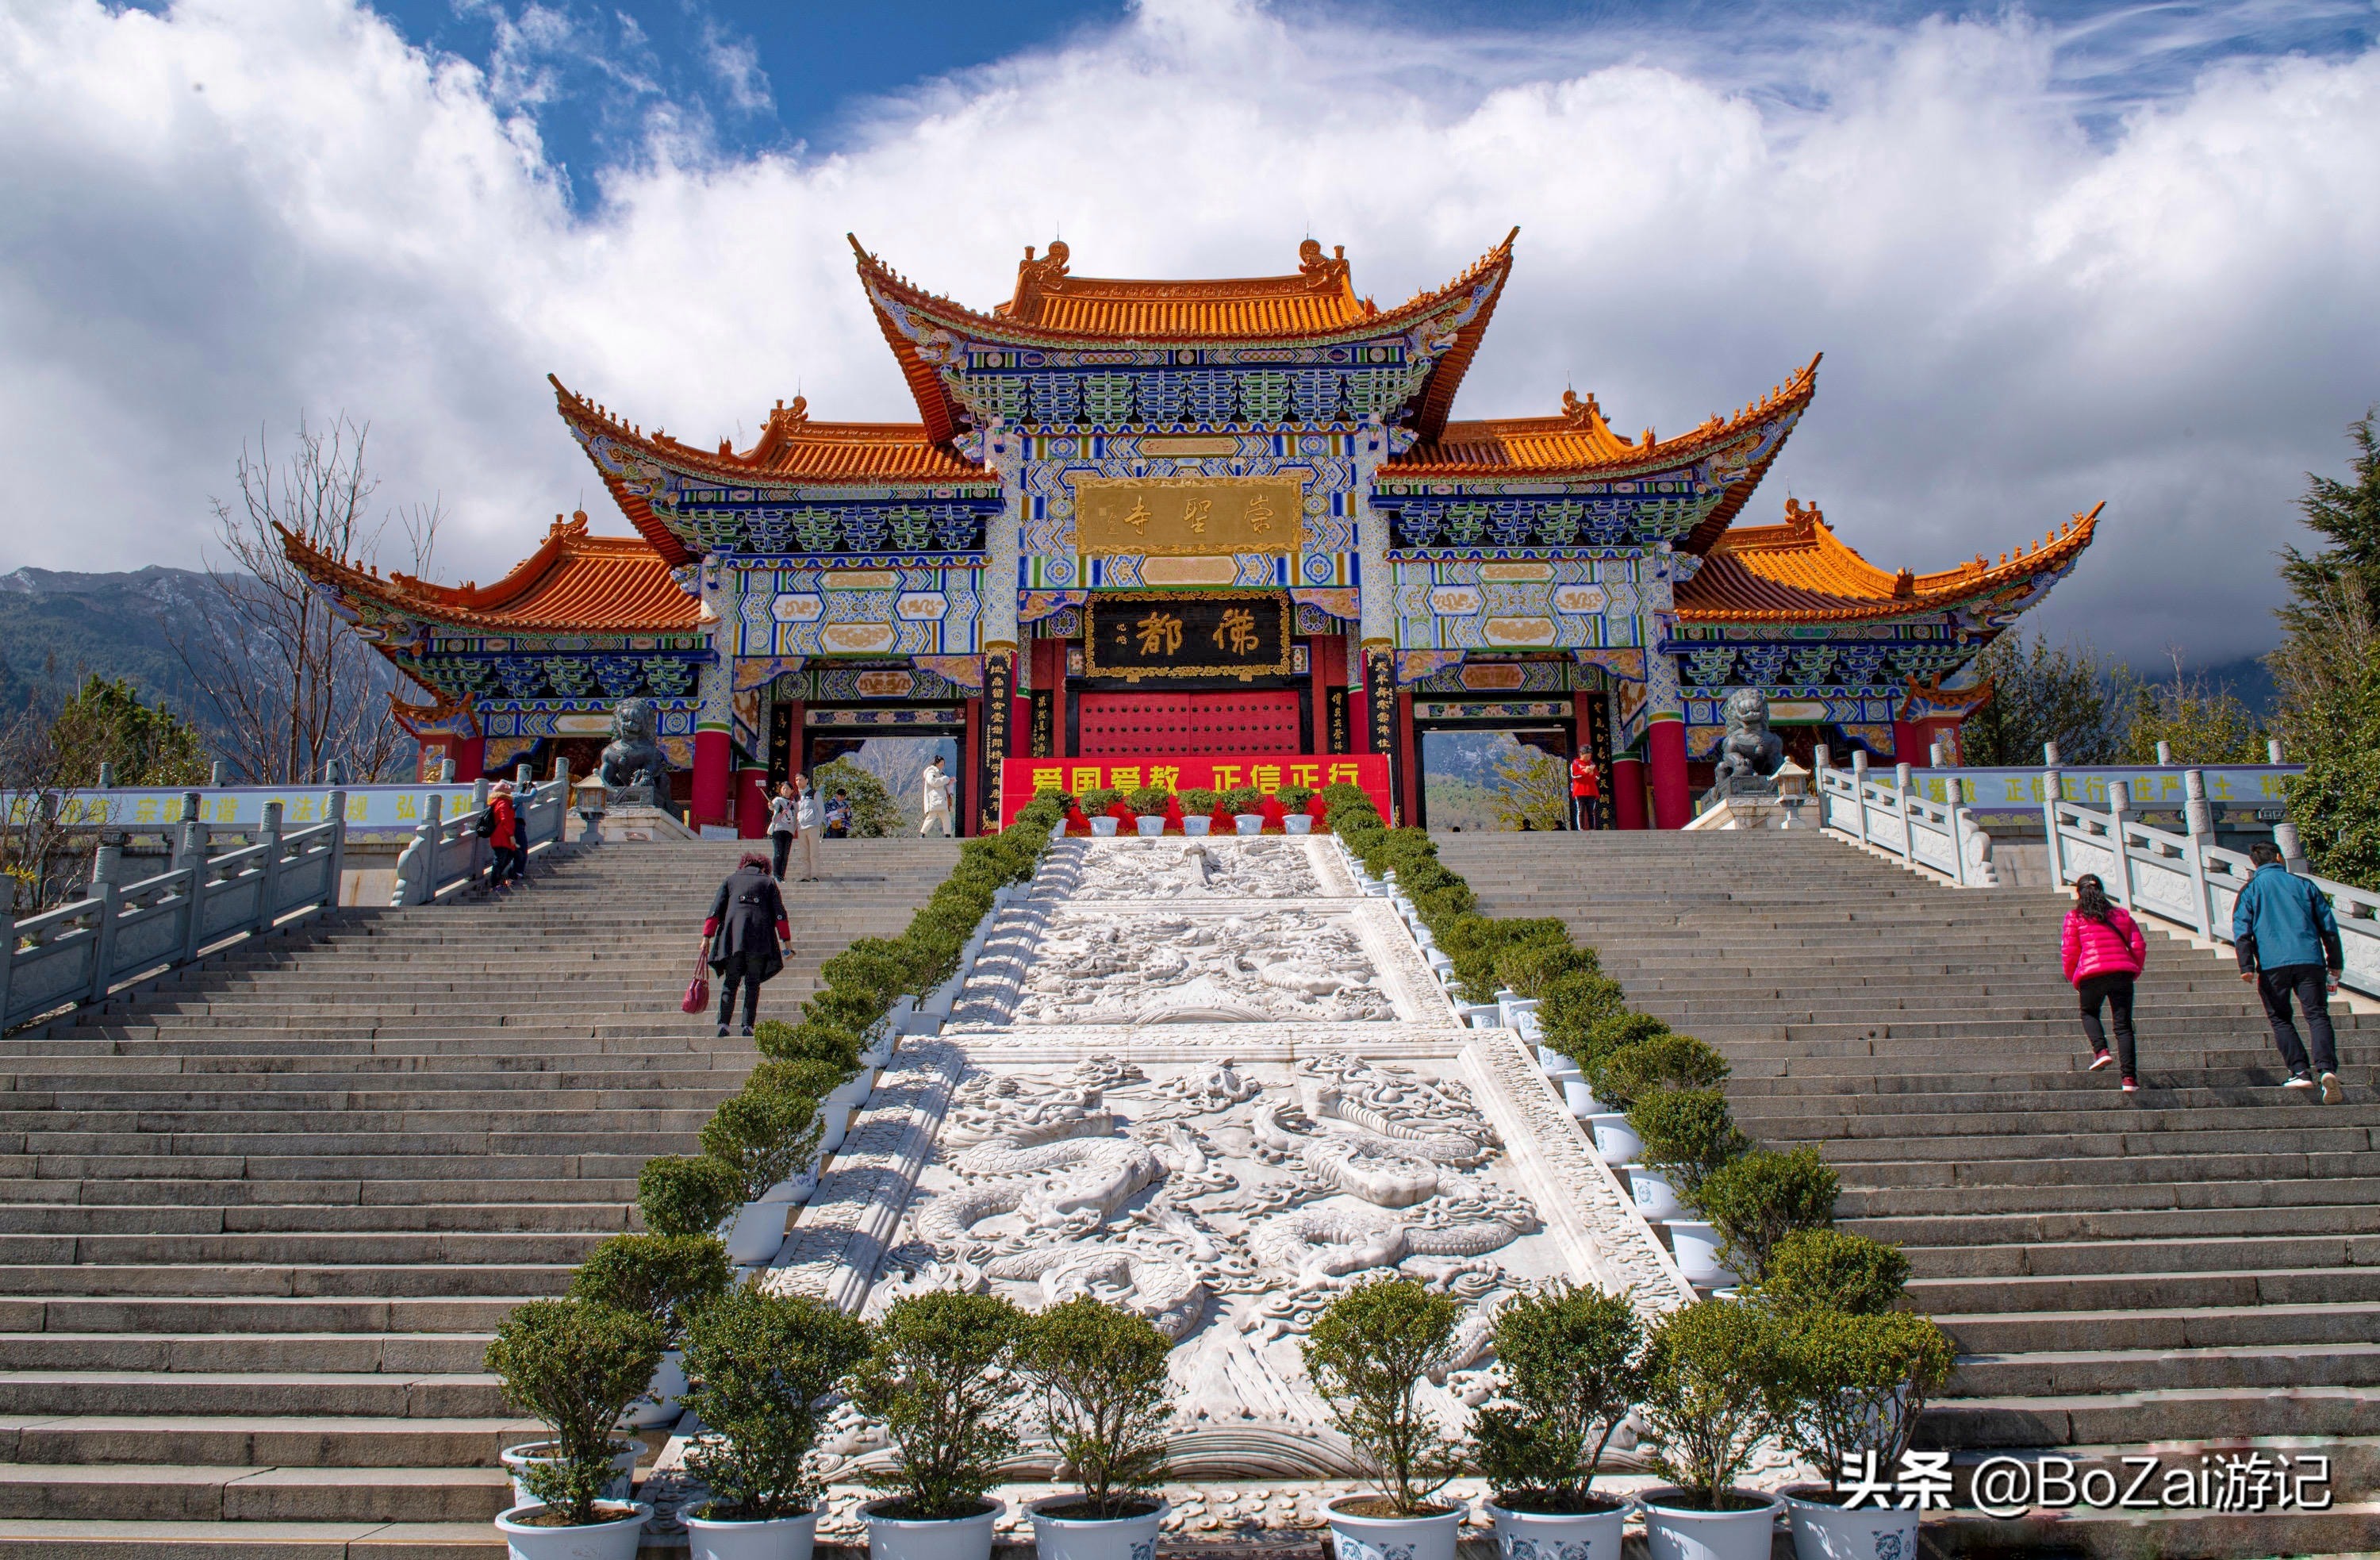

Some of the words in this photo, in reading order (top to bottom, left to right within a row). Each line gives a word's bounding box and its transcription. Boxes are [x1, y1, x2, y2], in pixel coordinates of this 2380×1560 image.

[1032, 766, 1180, 797] 爱国爱教
[1211, 763, 1359, 795] 正信正行
[2133, 774, 2235, 801] 庄严土
